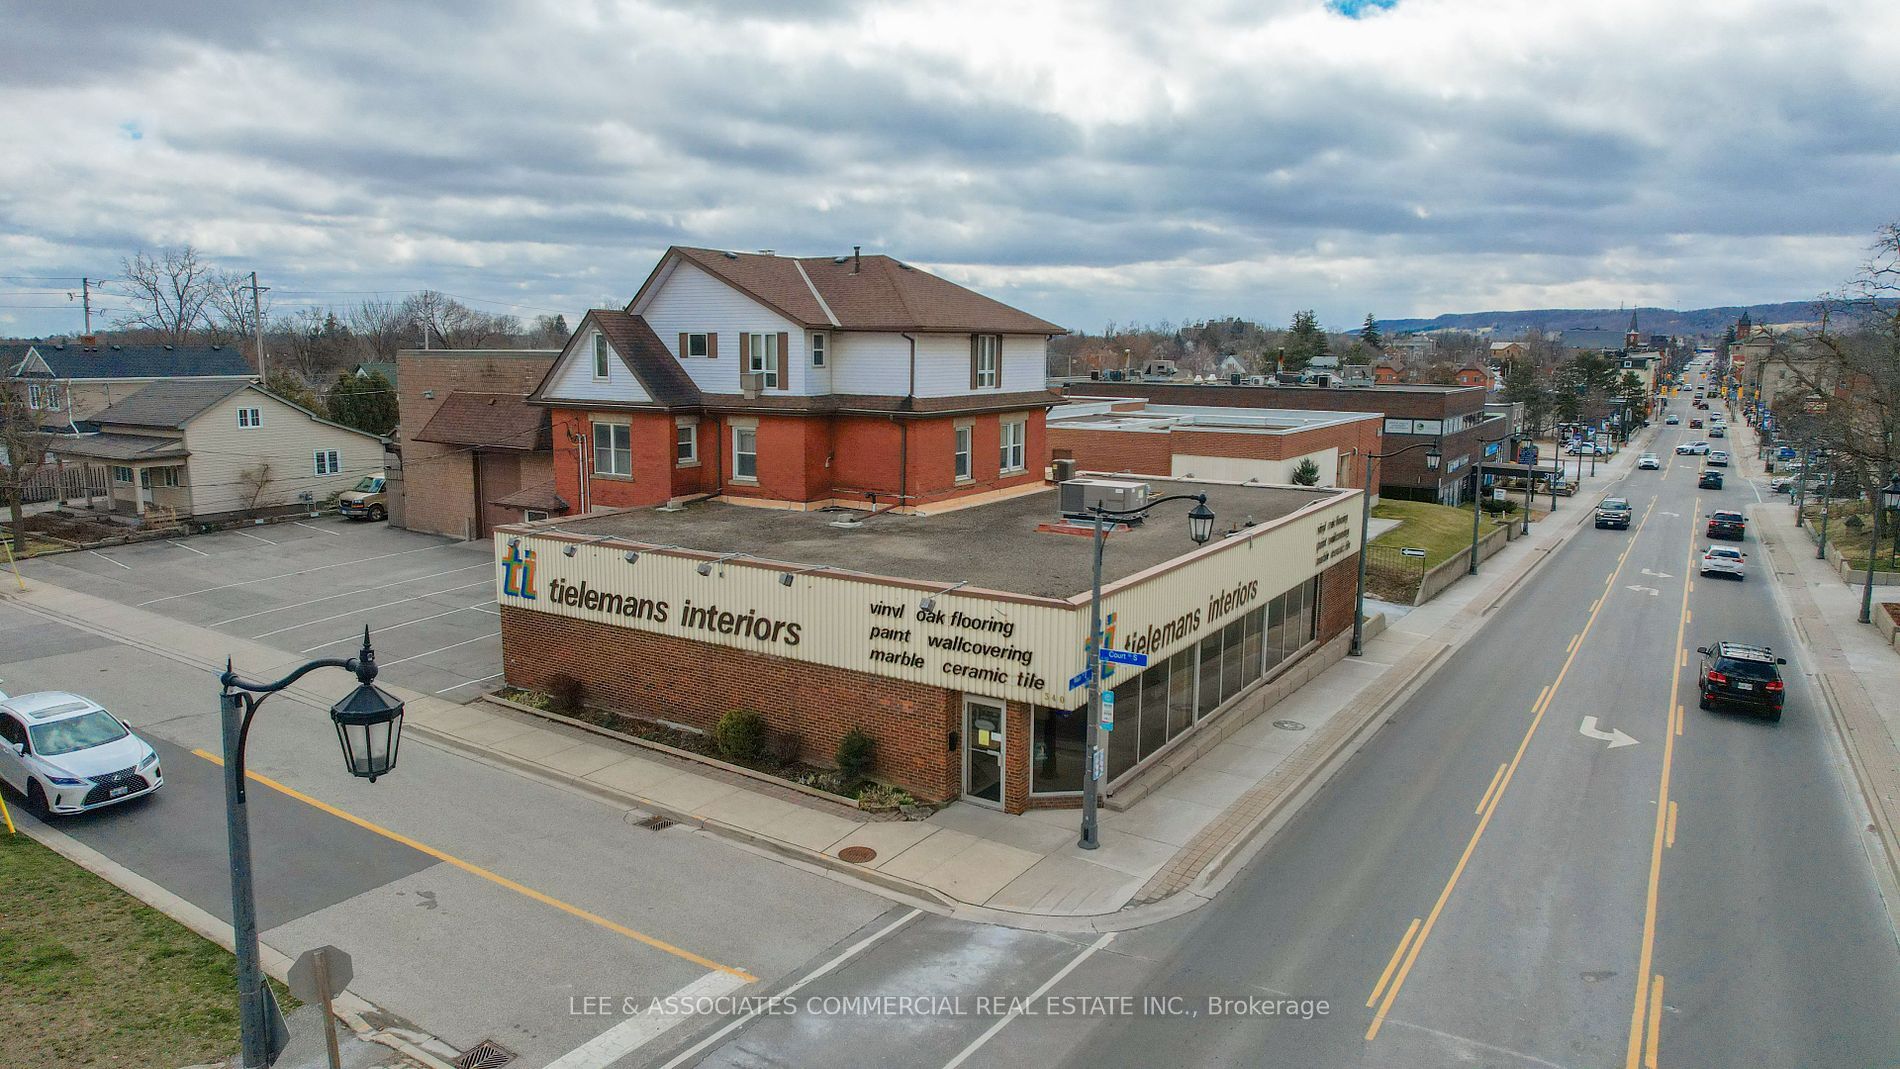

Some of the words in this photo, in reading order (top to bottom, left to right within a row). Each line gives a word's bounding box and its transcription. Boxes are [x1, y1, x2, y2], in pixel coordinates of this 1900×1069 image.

[549, 578, 669, 623] tielemans
[680, 599, 802, 646] interiors
[916, 610, 946, 625] oak
[950, 611, 1015, 638] flooring
[1124, 608, 1200, 654] tielemans
[1207, 580, 1258, 624] interiors
[869, 626, 911, 642] paint
[928, 635, 1033, 666] wallcovering
[1108, 651, 1126, 660] Court
[869, 649, 925, 668] marble
[942, 662, 1008, 684] ceramic
[1017, 672, 1045, 690] tile
[1044, 692, 1065, 704] 340
